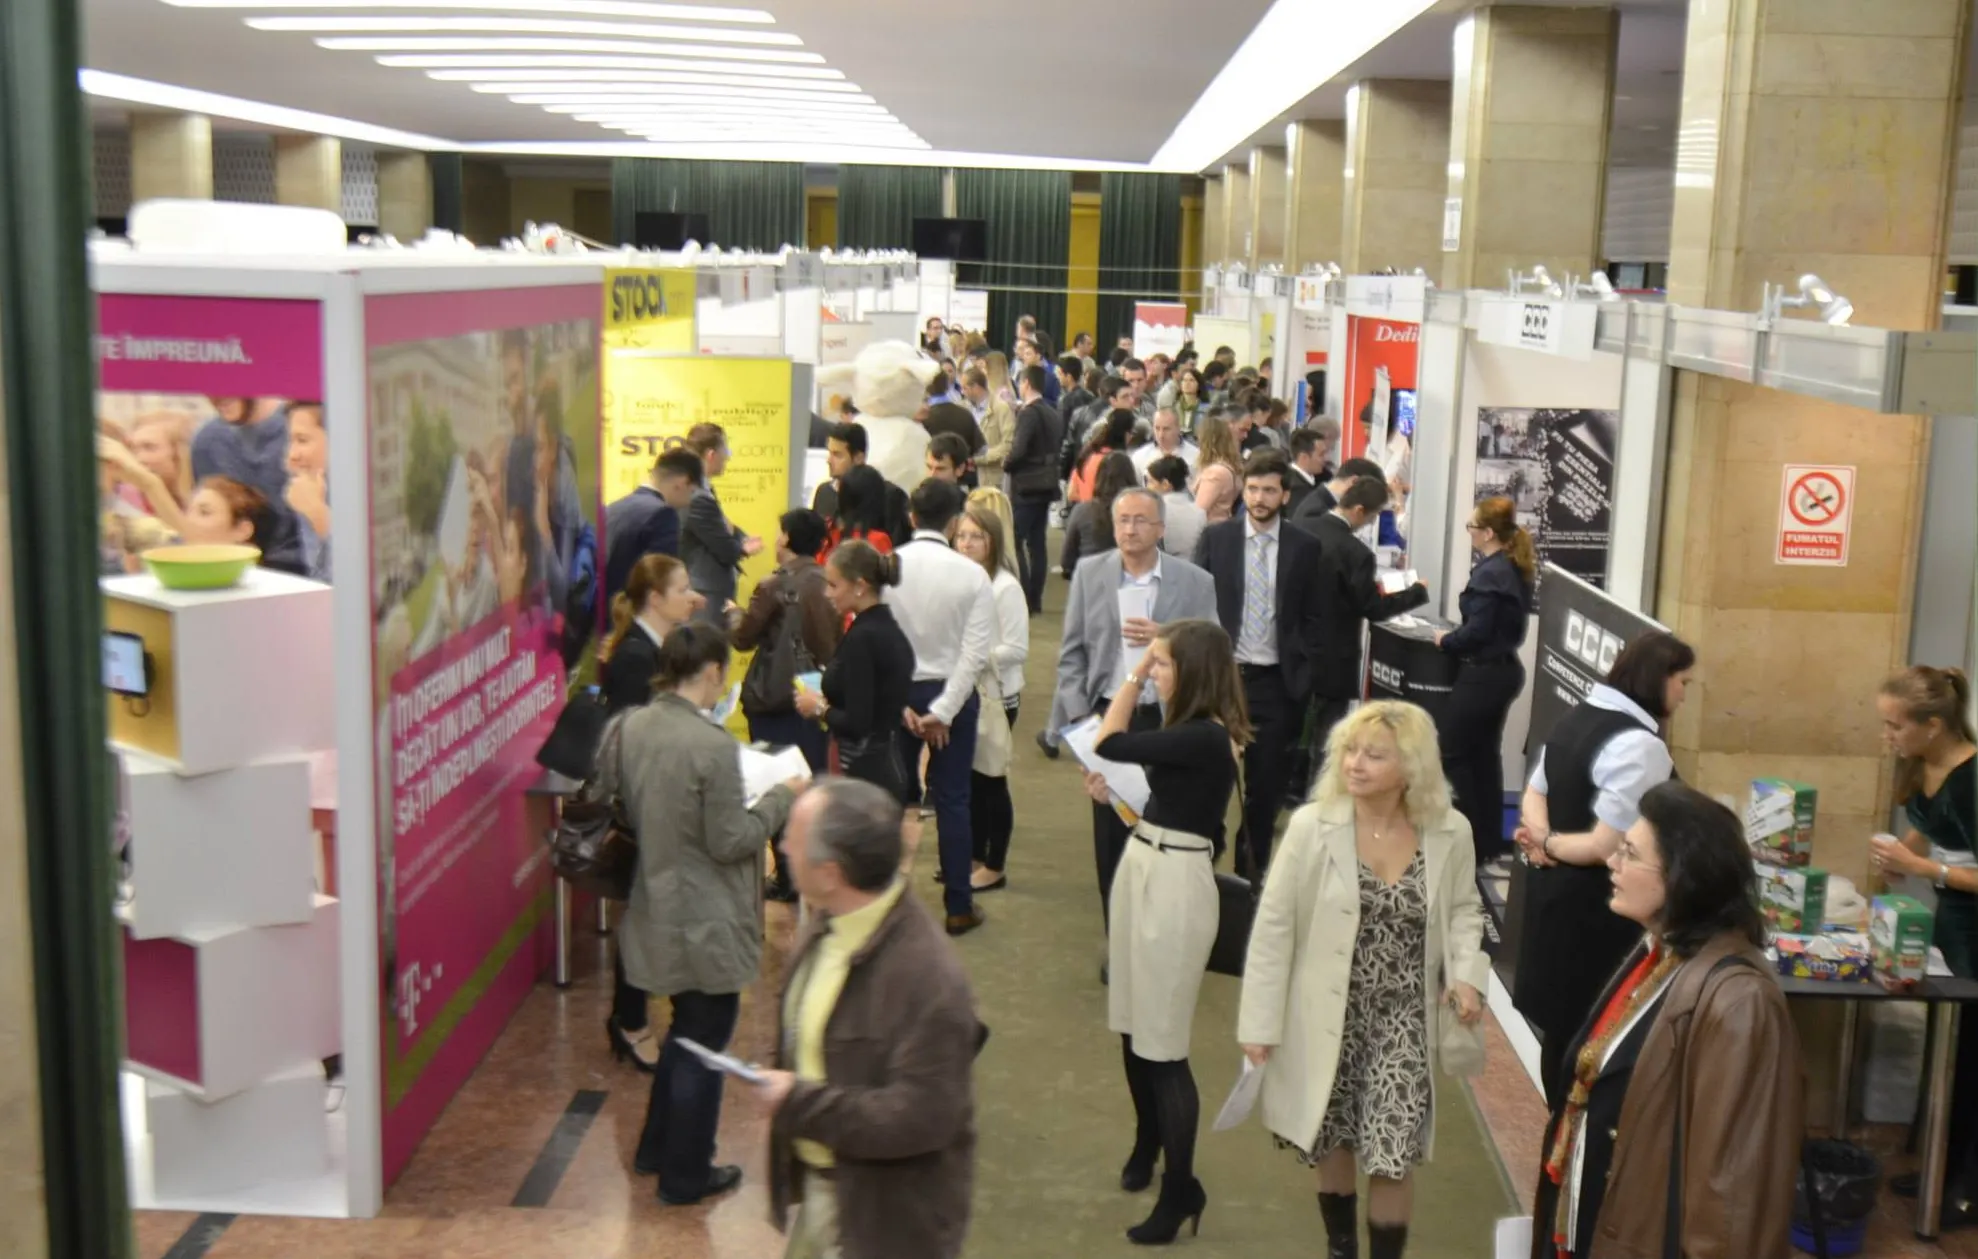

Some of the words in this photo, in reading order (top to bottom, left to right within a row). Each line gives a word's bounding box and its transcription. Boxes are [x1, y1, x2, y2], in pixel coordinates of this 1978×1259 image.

[1375, 324, 1421, 343] Dedi
[1786, 533, 1840, 544] FUMATUL
[1785, 547, 1837, 557] INTERZIS
[1566, 612, 1618, 675] CCC
[1372, 660, 1400, 688] CCC
